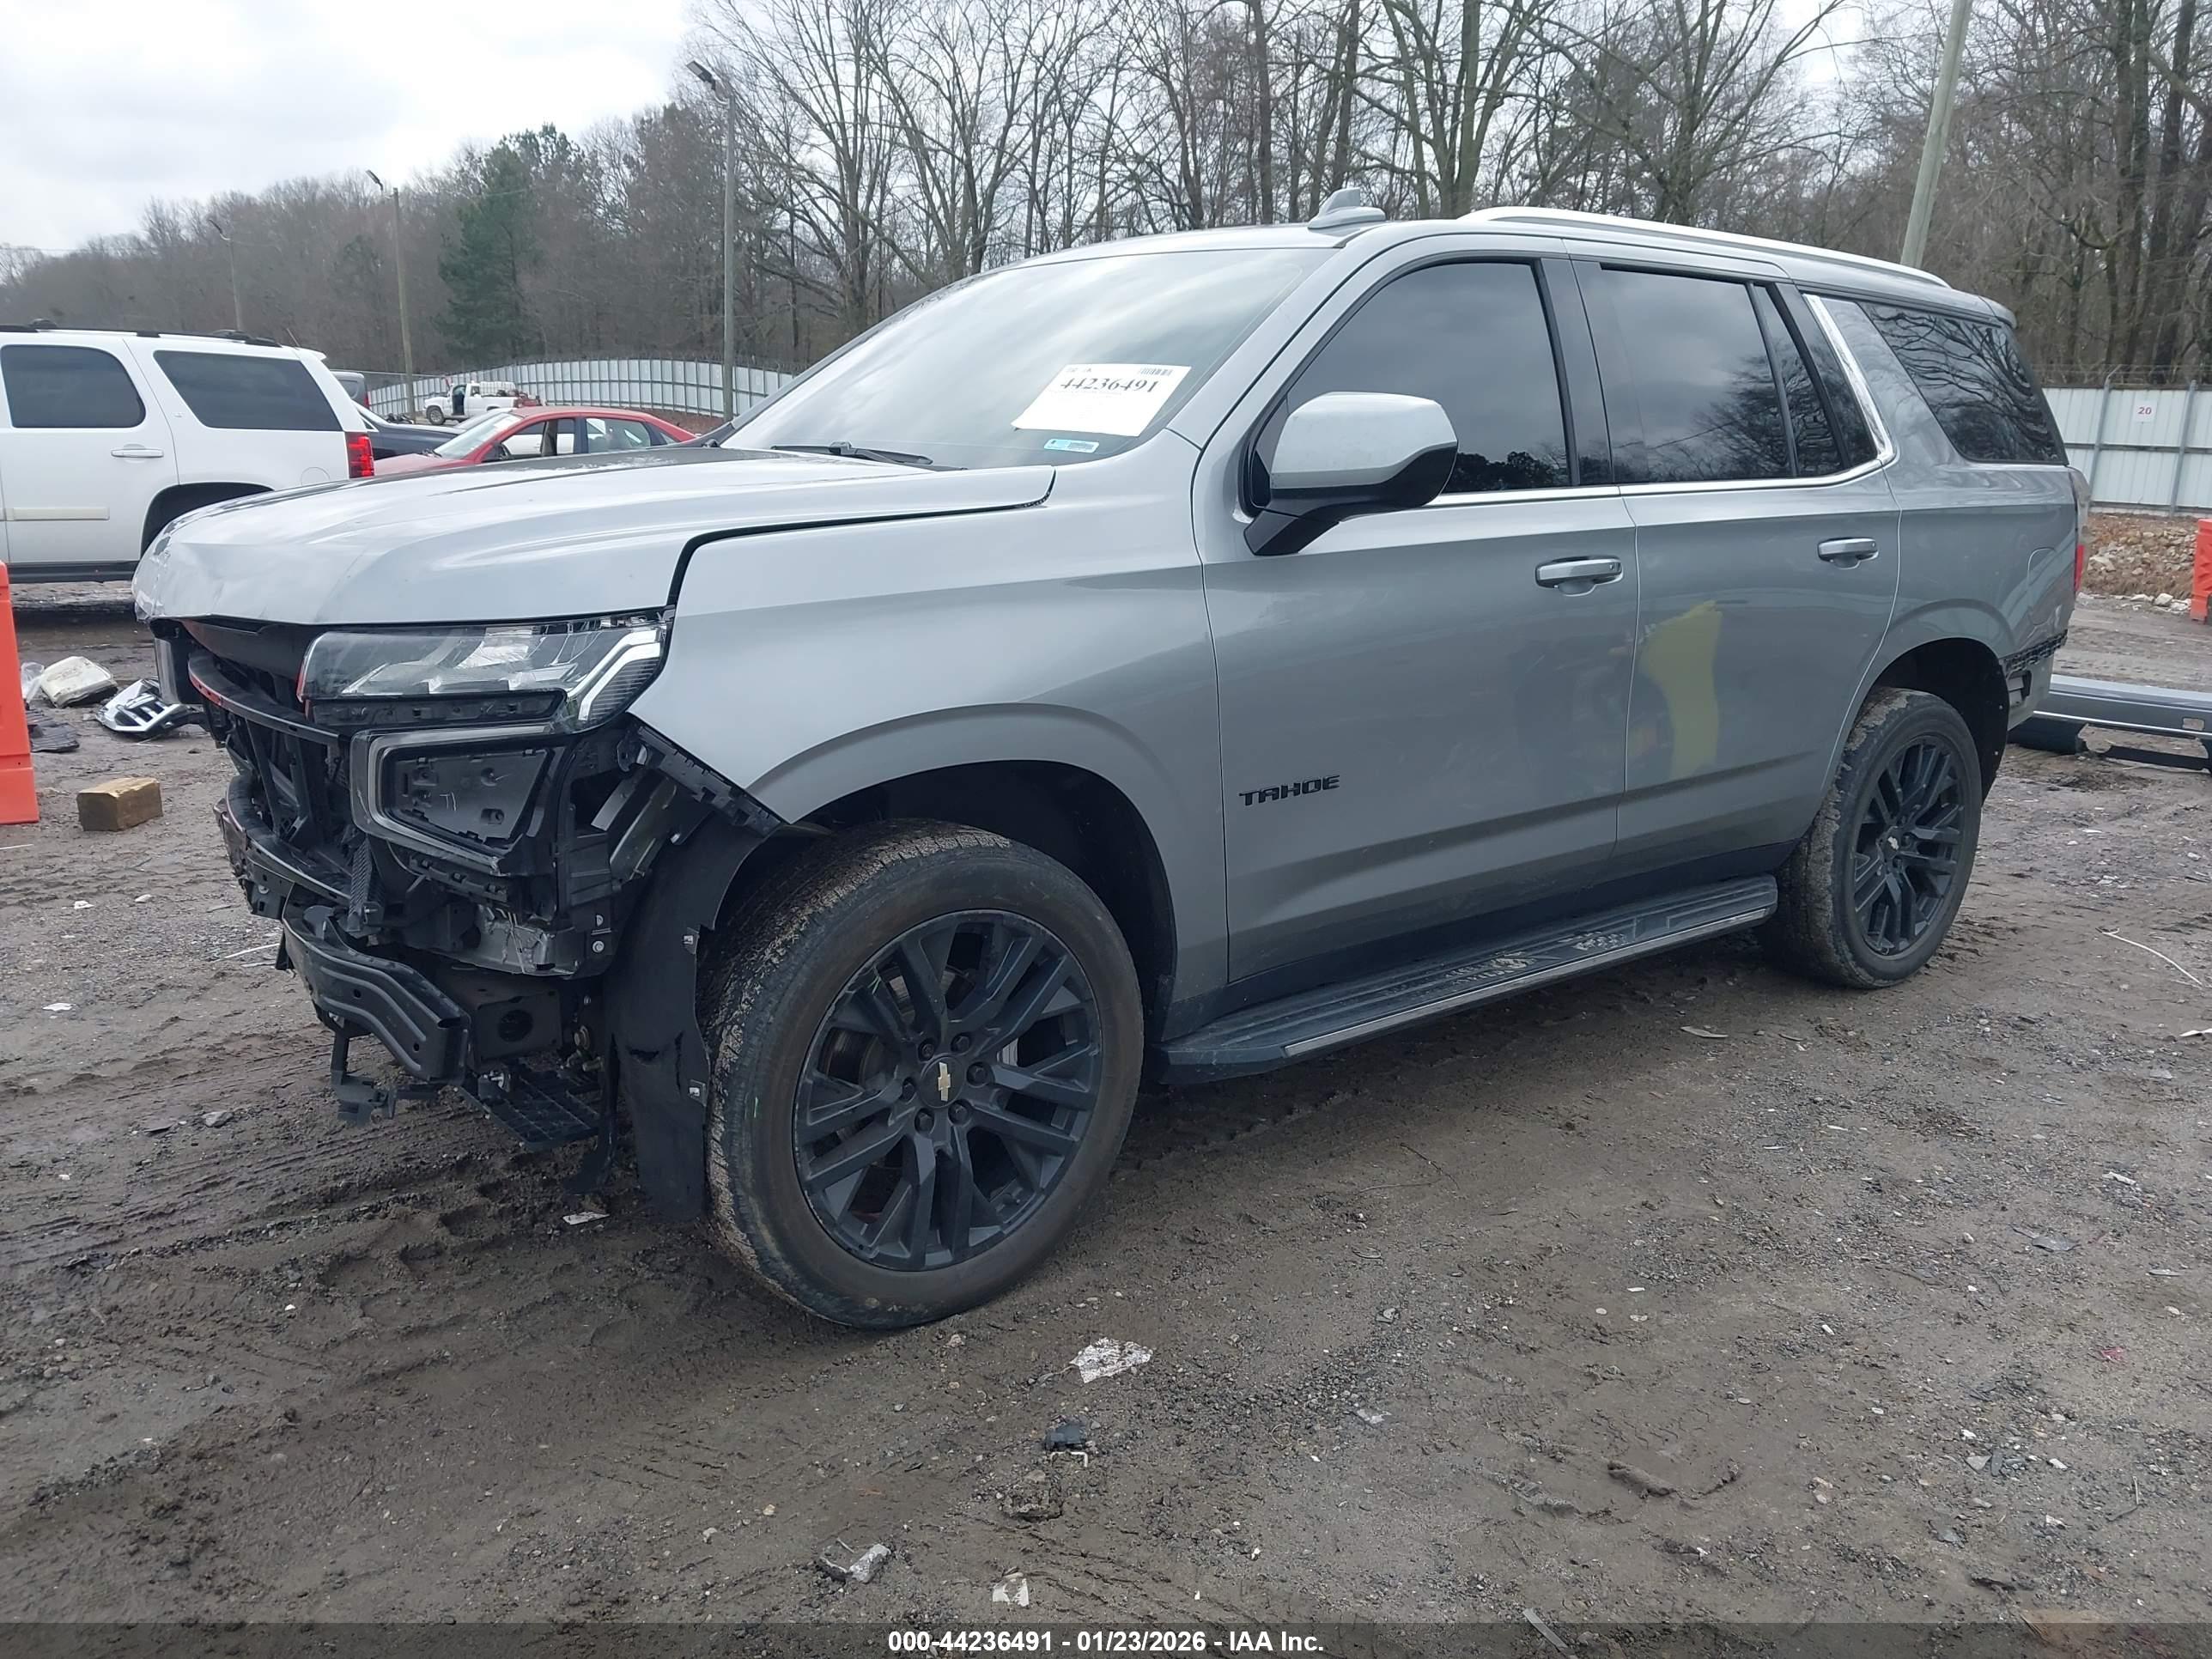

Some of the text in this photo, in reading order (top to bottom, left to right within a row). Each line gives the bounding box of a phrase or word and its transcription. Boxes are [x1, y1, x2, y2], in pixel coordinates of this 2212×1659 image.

[1060, 377, 1160, 392] 44236491
[2137, 406, 2152, 416] 20
[1238, 775, 1340, 806] TAHOE
